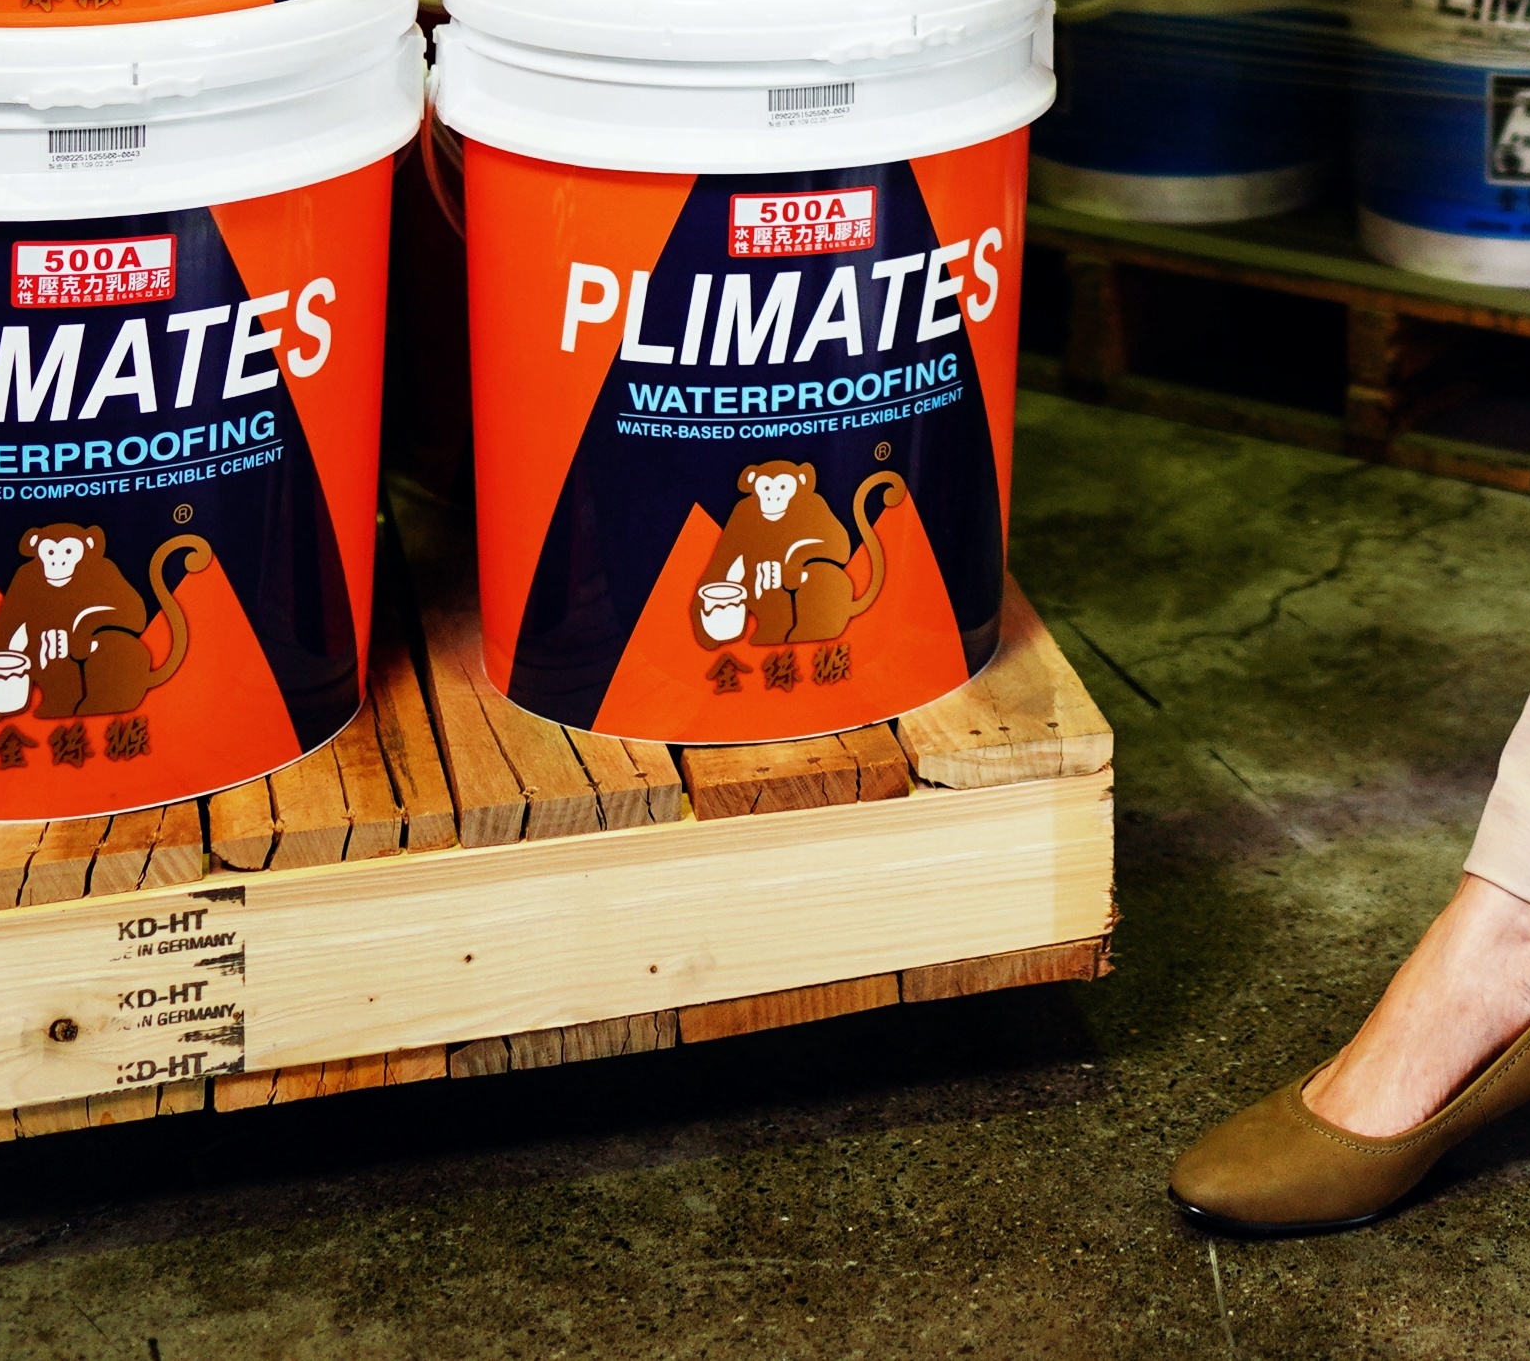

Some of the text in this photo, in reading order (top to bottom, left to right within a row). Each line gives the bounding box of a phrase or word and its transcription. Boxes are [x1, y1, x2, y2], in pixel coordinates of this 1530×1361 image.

[760, 199, 846, 223] 500A
[44, 247, 142, 272] 500A
[560, 226, 1002, 367] PLIMATES
[628, 353, 957, 414] WATERPROOFING
[20, 478, 131, 500] COMPOSITE
[135, 464, 217, 492] FLEXIBLE
[220, 445, 284, 476] CEMENT
[118, 908, 208, 941] KD-HT
[138, 943, 153, 957] IN
[157, 932, 236, 955] GERMANY
[118, 980, 208, 1011] KD-HT
[157, 1003, 236, 1026] GERMANY
